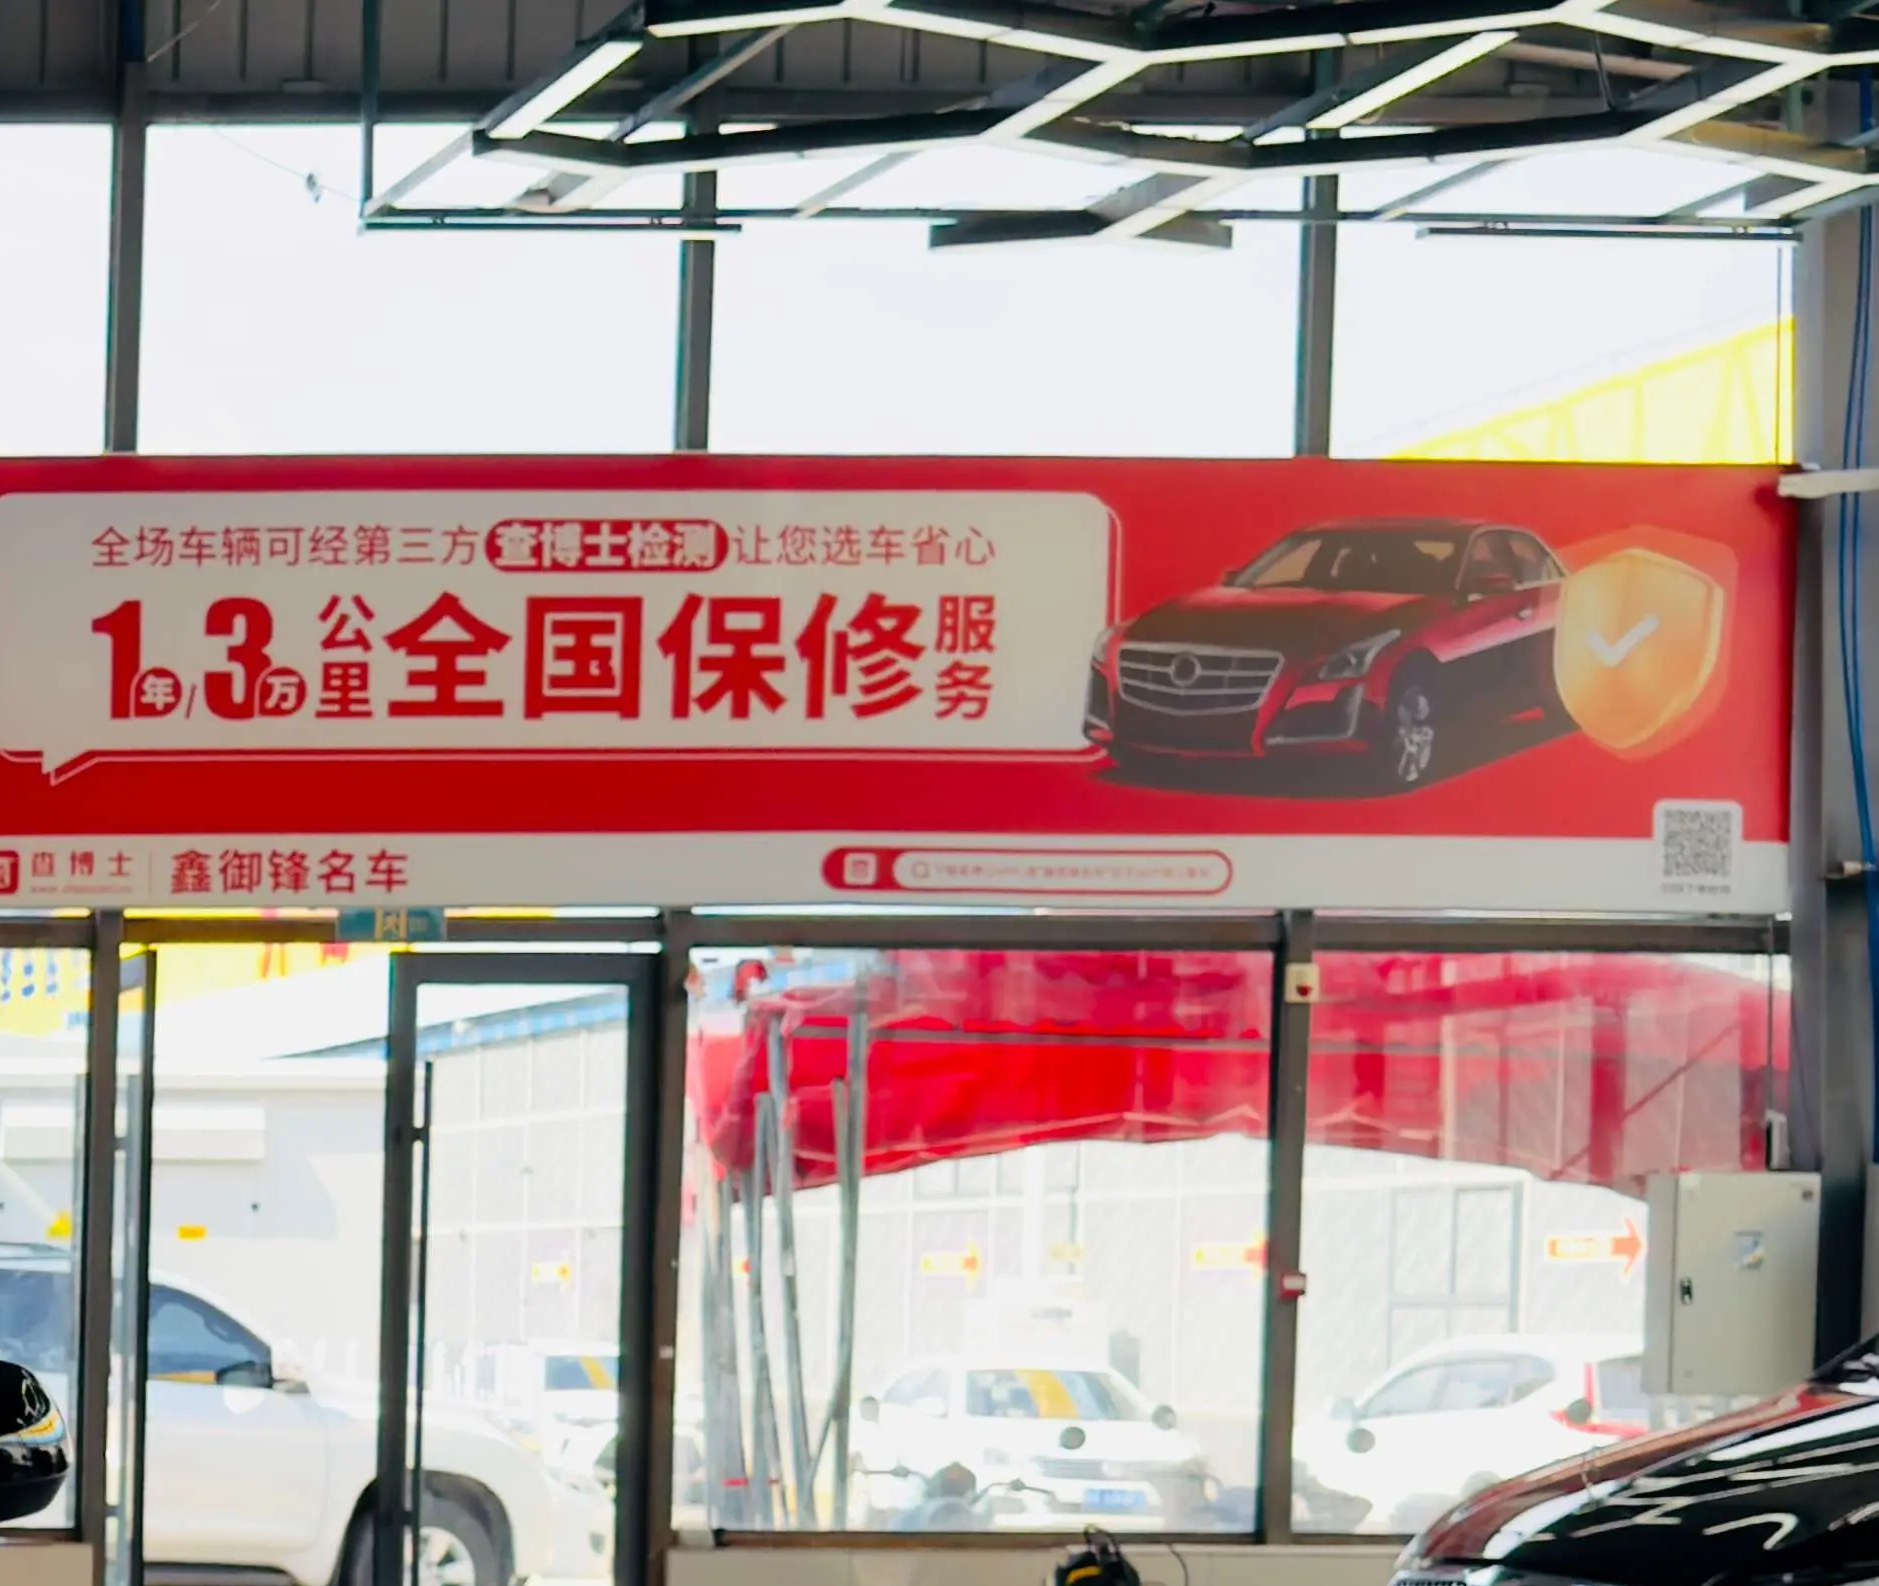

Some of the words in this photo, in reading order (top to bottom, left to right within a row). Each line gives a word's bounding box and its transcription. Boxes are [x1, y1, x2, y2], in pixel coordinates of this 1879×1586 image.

[384, 593, 924, 721] 全国保修
[171, 848, 408, 895] 鑫御锋名车
